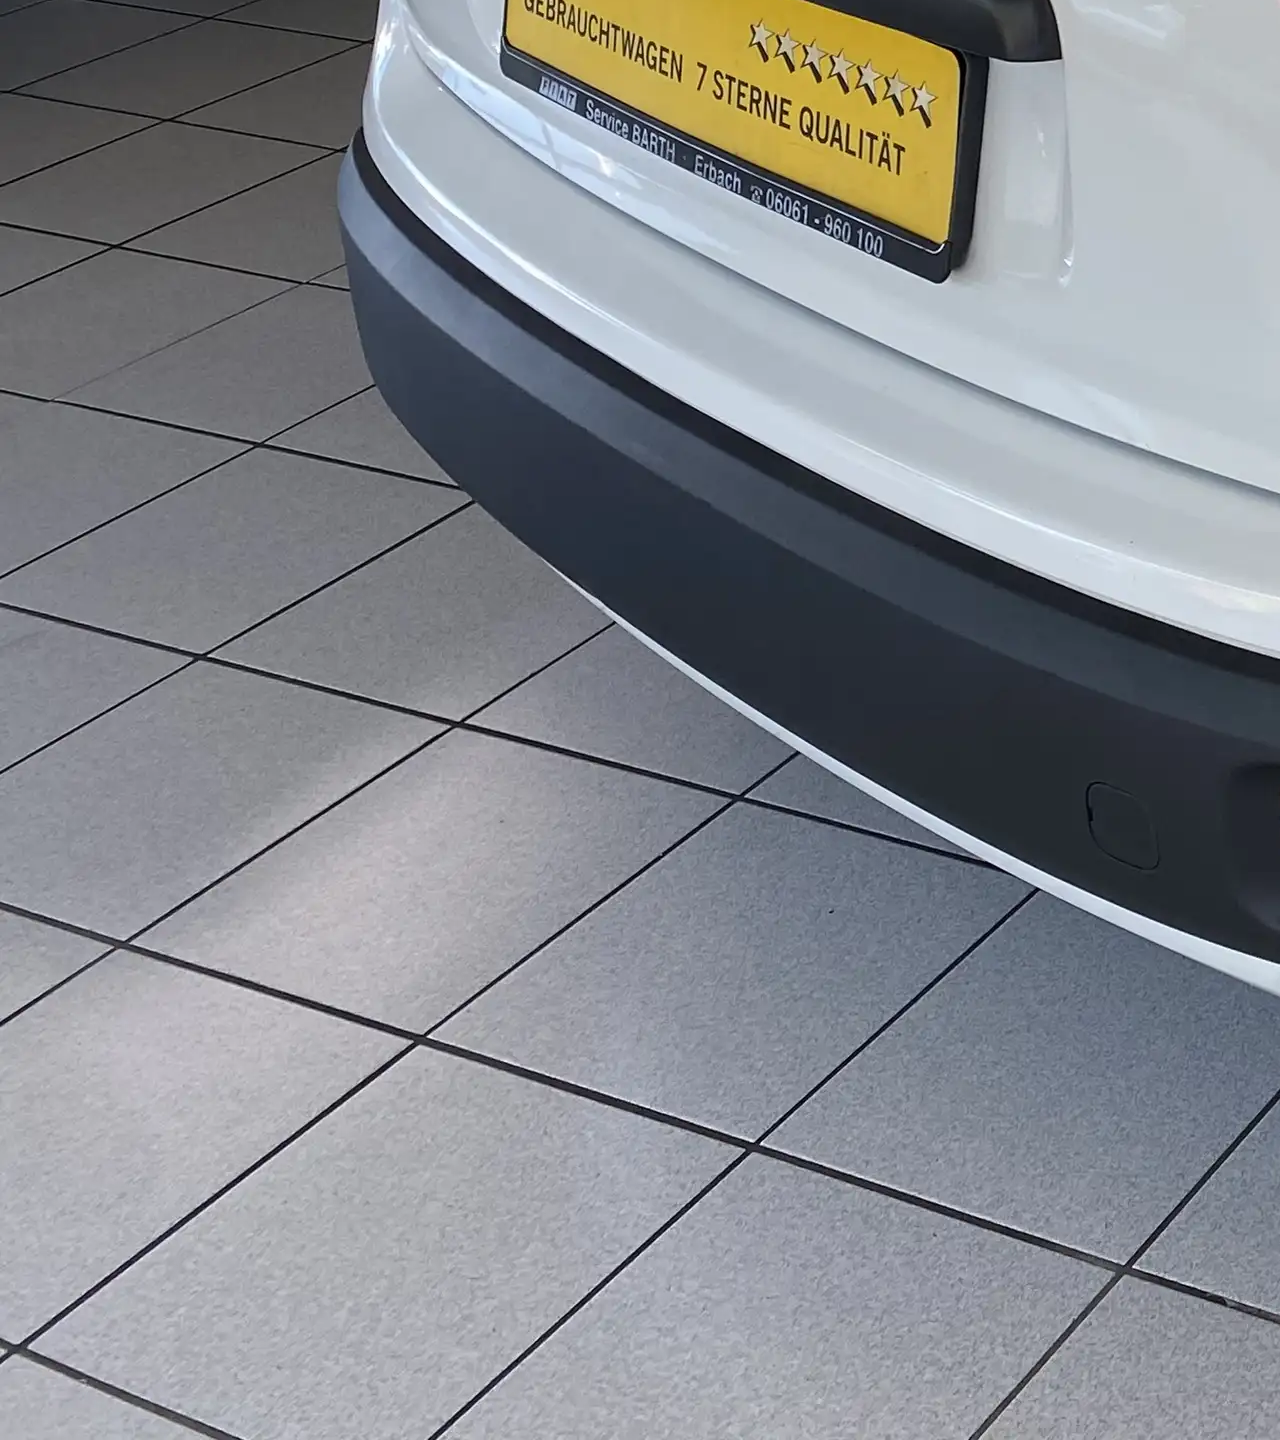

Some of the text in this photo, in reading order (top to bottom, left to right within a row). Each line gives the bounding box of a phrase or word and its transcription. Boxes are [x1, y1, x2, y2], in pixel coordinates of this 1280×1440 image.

[539, 76, 578, 111] FIAT
[585, 99, 628, 139] Service
[632, 124, 676, 162] BARTH
[694, 152, 741, 194] Erbach
[766, 189, 809, 225] 06061
[824, 214, 850, 243] 960
[856, 228, 883, 257] 100
[697, 63, 708, 91] 7
[713, 70, 791, 130] STERNE
[800, 106, 906, 176] QUALITÄT
